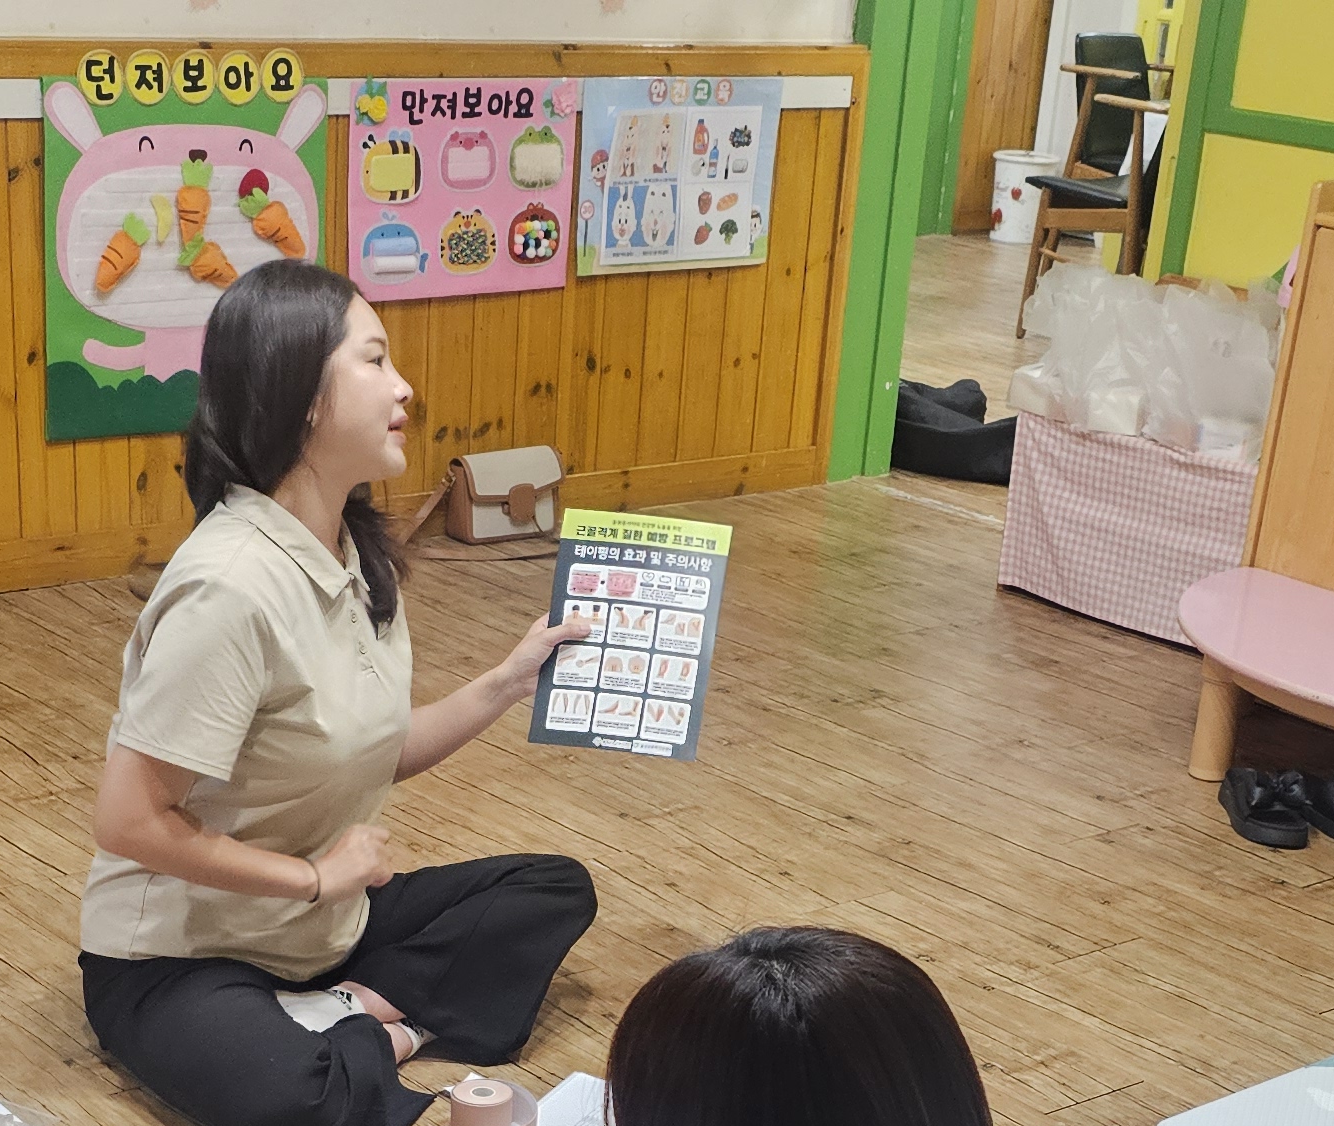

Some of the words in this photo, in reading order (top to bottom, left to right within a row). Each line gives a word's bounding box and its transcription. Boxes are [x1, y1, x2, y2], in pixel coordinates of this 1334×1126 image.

[83, 56, 297, 99] 던져보아요
[400, 86, 535, 125] 만져보아요
[576, 525, 618, 538] 근골격계
[622, 529, 643, 541] 질환
[647, 531, 669, 543] 예방
[672, 534, 716, 550] 프로그램
[574, 545, 620, 561] 테이핑의
[623, 549, 647, 563] 효과
[650, 552, 662, 565] 및
[665, 554, 712, 572] 주의사항
